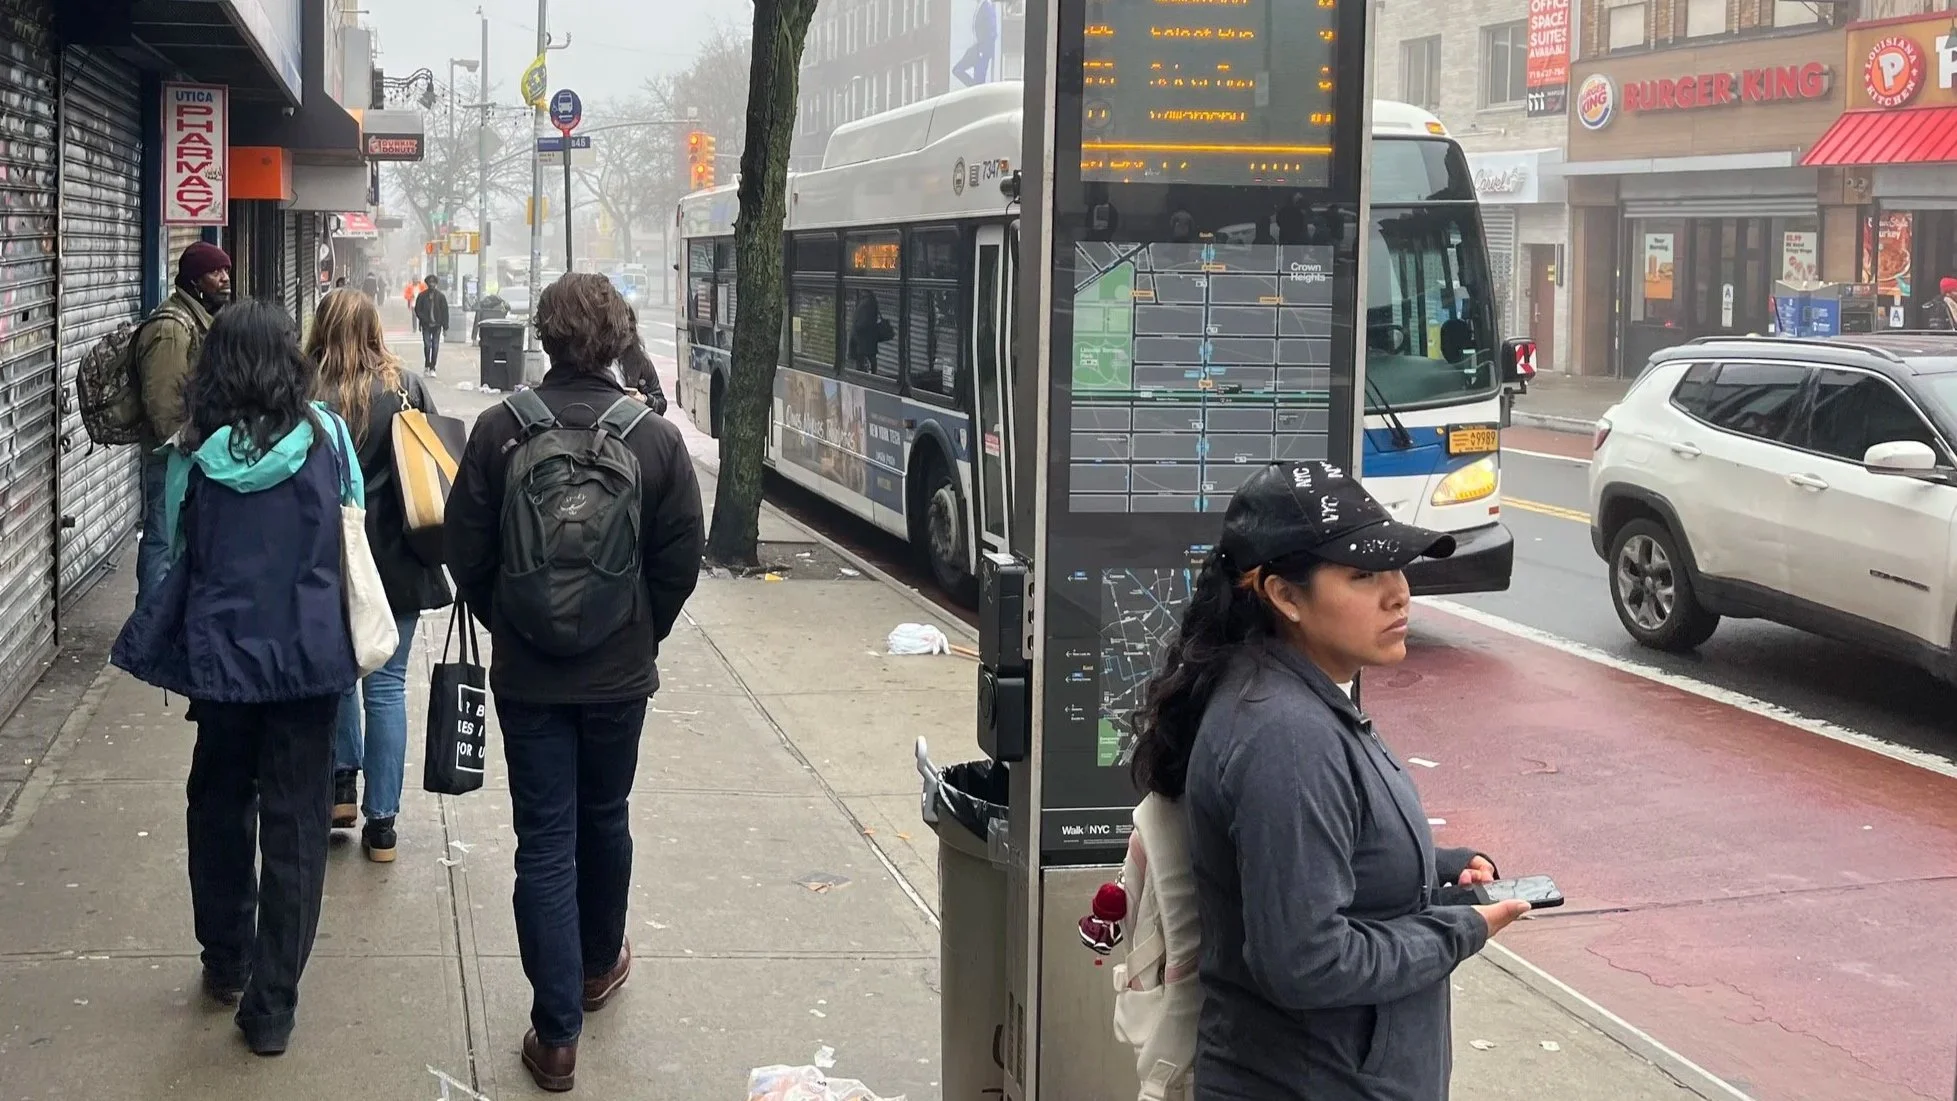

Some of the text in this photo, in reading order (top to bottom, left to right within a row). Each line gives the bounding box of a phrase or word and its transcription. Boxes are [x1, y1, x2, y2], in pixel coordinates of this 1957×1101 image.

[1865, 37, 1917, 69] LOUISIANA
[1879, 52, 1905, 90] P
[176, 90, 213, 102] UTICA
[1623, 61, 1833, 113] BURGER KING
[1867, 79, 1916, 106] KITCHEN
[176, 104, 213, 217] PHARMACY
[983, 159, 1001, 180] 7347
[1291, 262, 1322, 271] Crown
[1291, 272, 1326, 283] Heights
[1724, 287, 1732, 299] A
[1892, 309, 1901, 322] A
[1477, 430, 1497, 447] 9989
[1292, 467, 1312, 488] NYC
[1062, 825, 1084, 835] Walk
[1089, 825, 1110, 834] NYC
